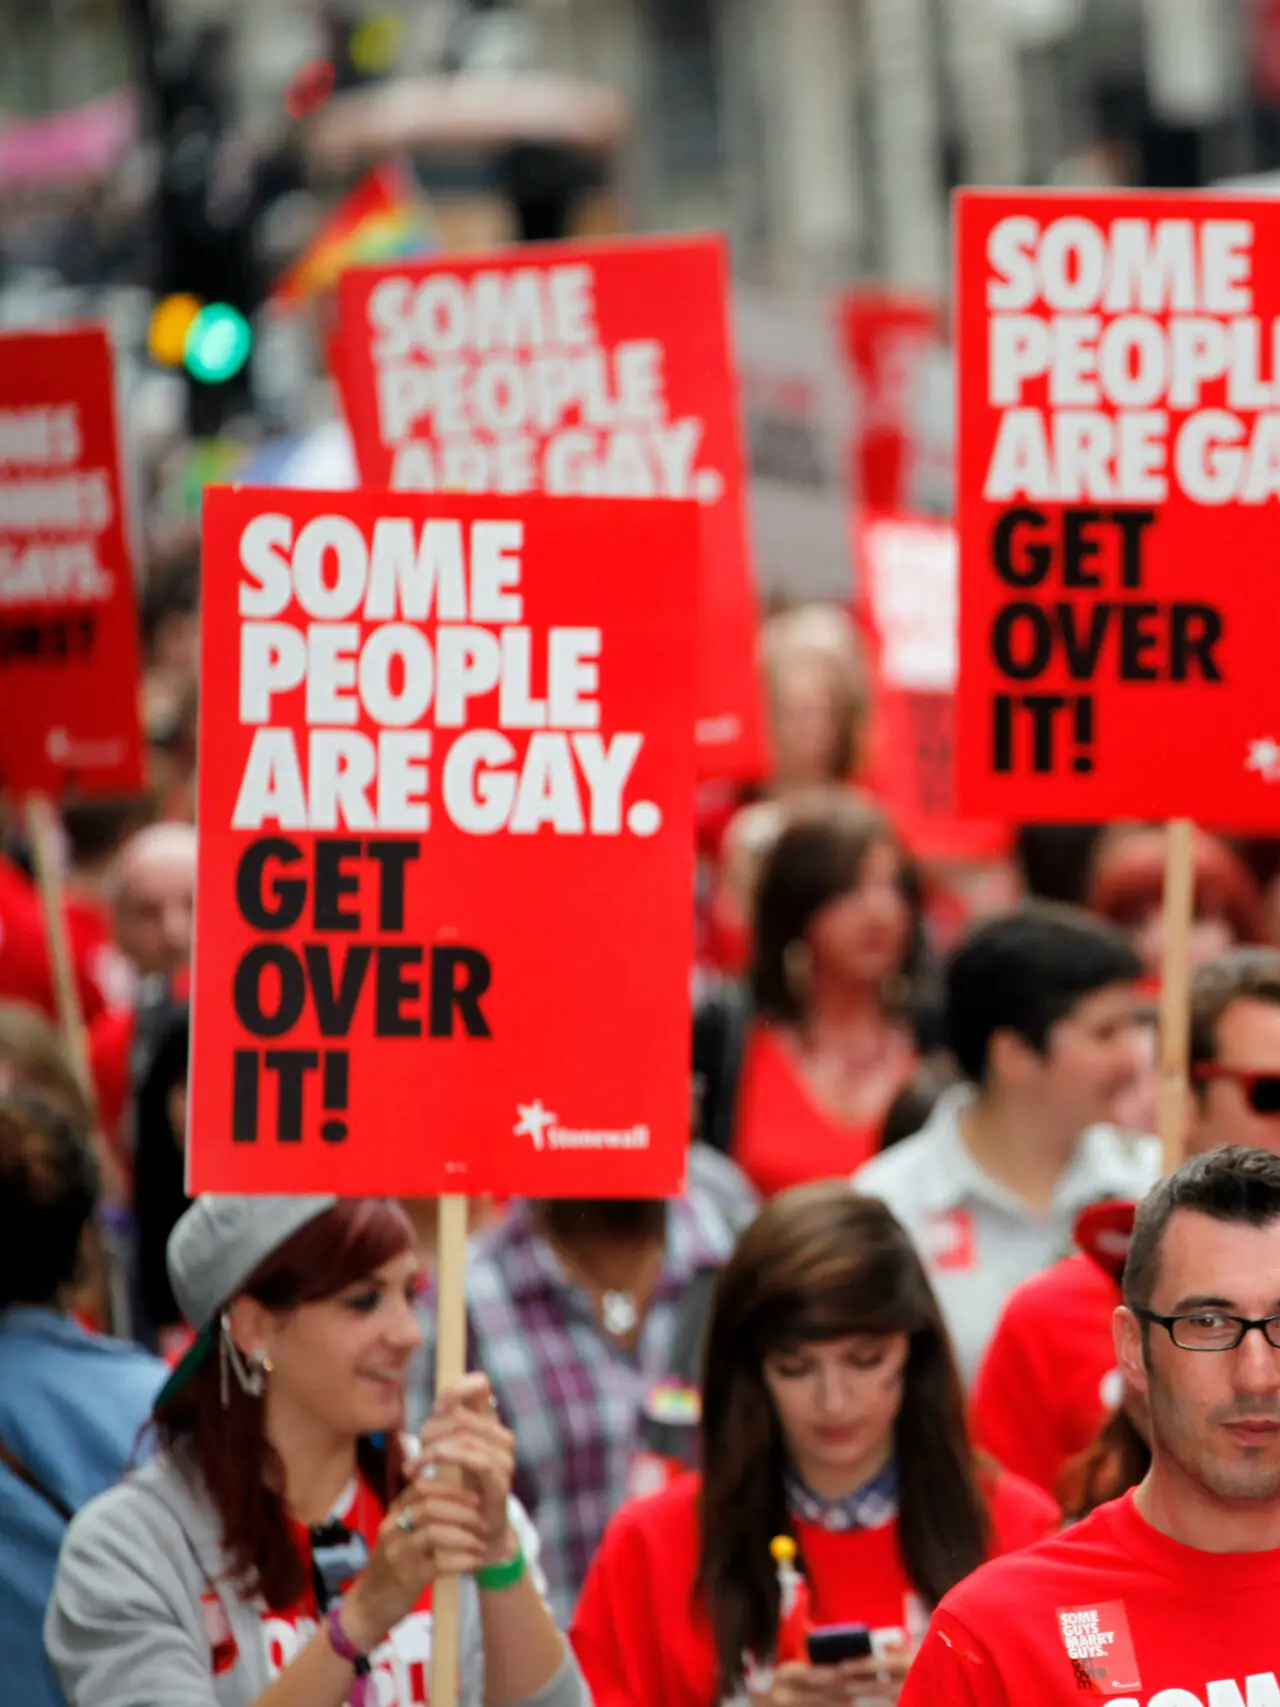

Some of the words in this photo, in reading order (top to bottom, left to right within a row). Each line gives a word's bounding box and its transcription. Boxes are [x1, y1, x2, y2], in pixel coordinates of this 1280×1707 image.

[984, 215, 1255, 312] SOME
[368, 263, 597, 362] SOME
[377, 337, 666, 448] PEOPLE
[983, 410, 1169, 503] ARE
[236, 513, 523, 623] SOME
[990, 507, 1156, 589] GET
[237, 623, 601, 728] PEOPLE
[991, 600, 1224, 682] OVER
[992, 693, 1095, 774] IT!
[231, 728, 430, 832] ARE
[442, 730, 661, 836] GAY.
[235, 837, 421, 932] GET
[232, 942, 492, 1038] OVER
[231, 1050, 350, 1143] IT!
[1060, 1610, 1099, 1626] SOME
[1063, 1622, 1099, 1637] GUYS
[1066, 1631, 1115, 1649] MARRY
[1068, 1645, 1109, 1660] GUYS.
